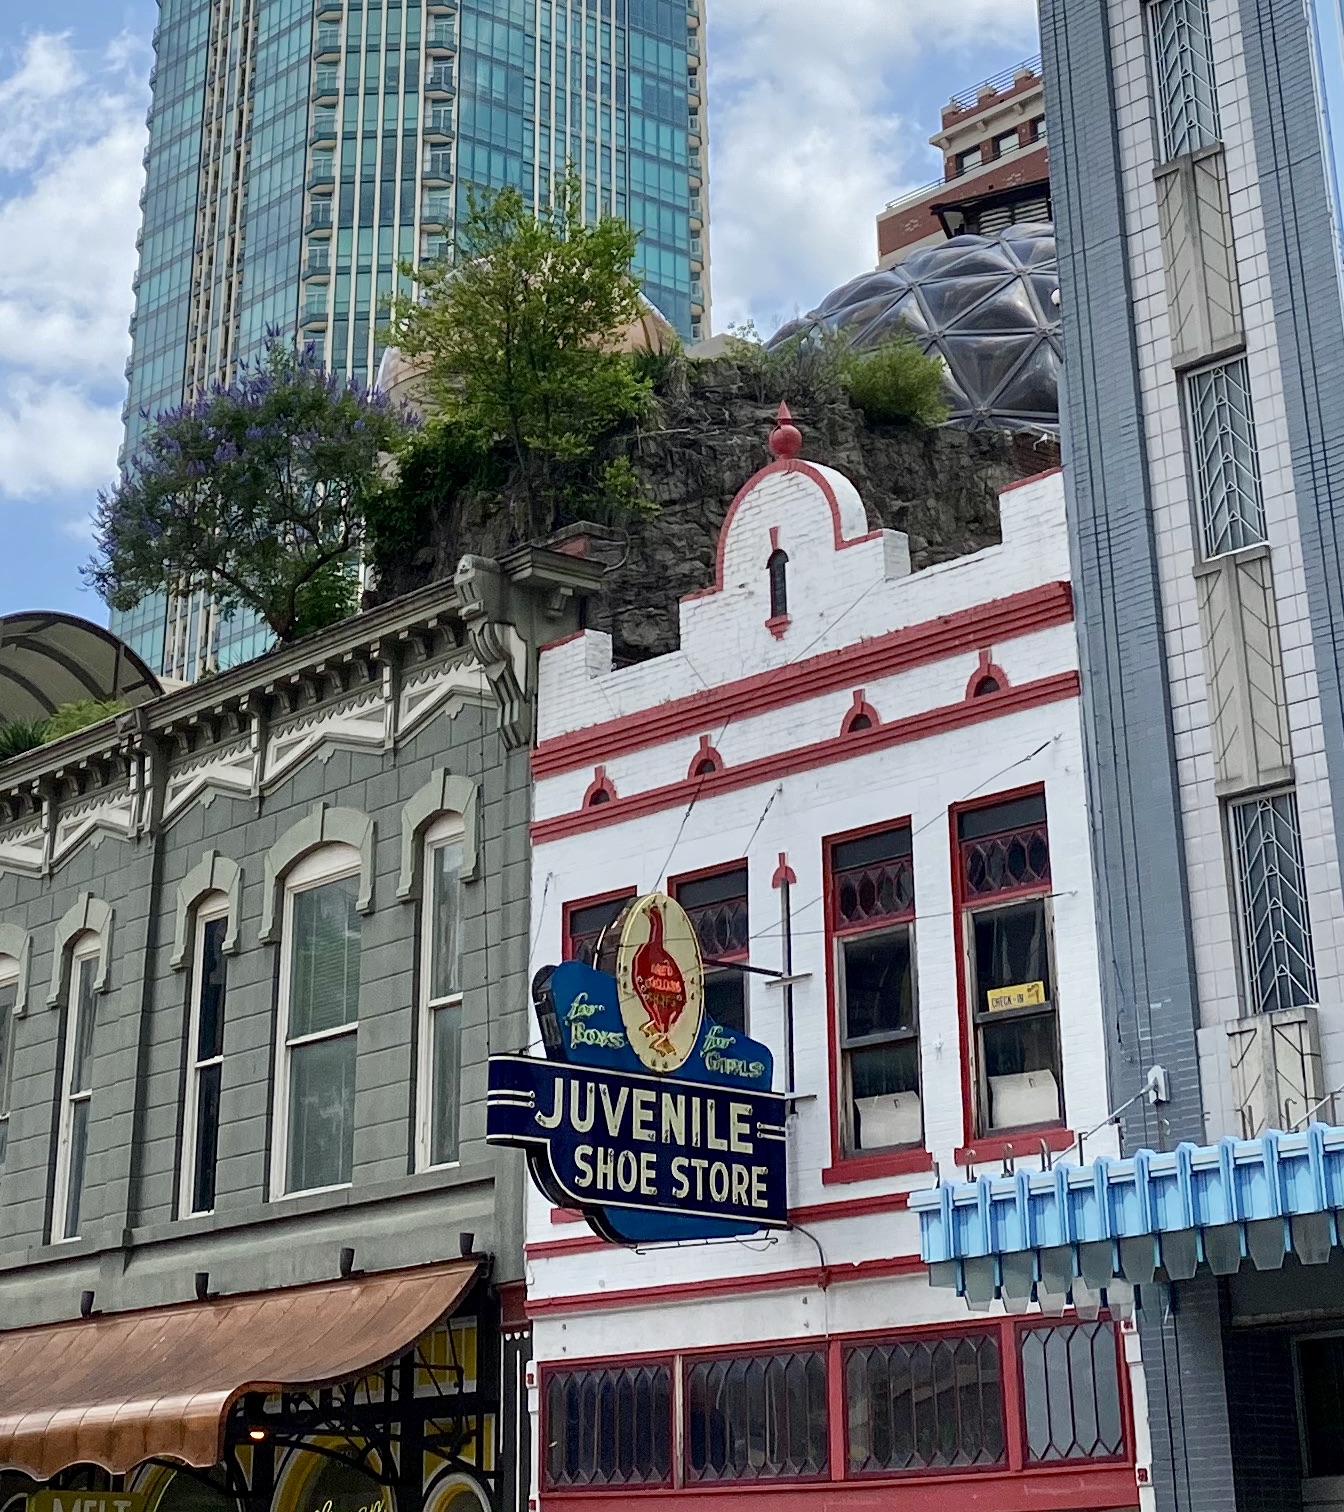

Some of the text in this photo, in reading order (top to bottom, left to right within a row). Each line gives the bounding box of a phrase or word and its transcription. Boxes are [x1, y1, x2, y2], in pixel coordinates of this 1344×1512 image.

[534, 1077, 754, 1154] JUVENILE
[574, 1145, 769, 1208] SHOE STORE
